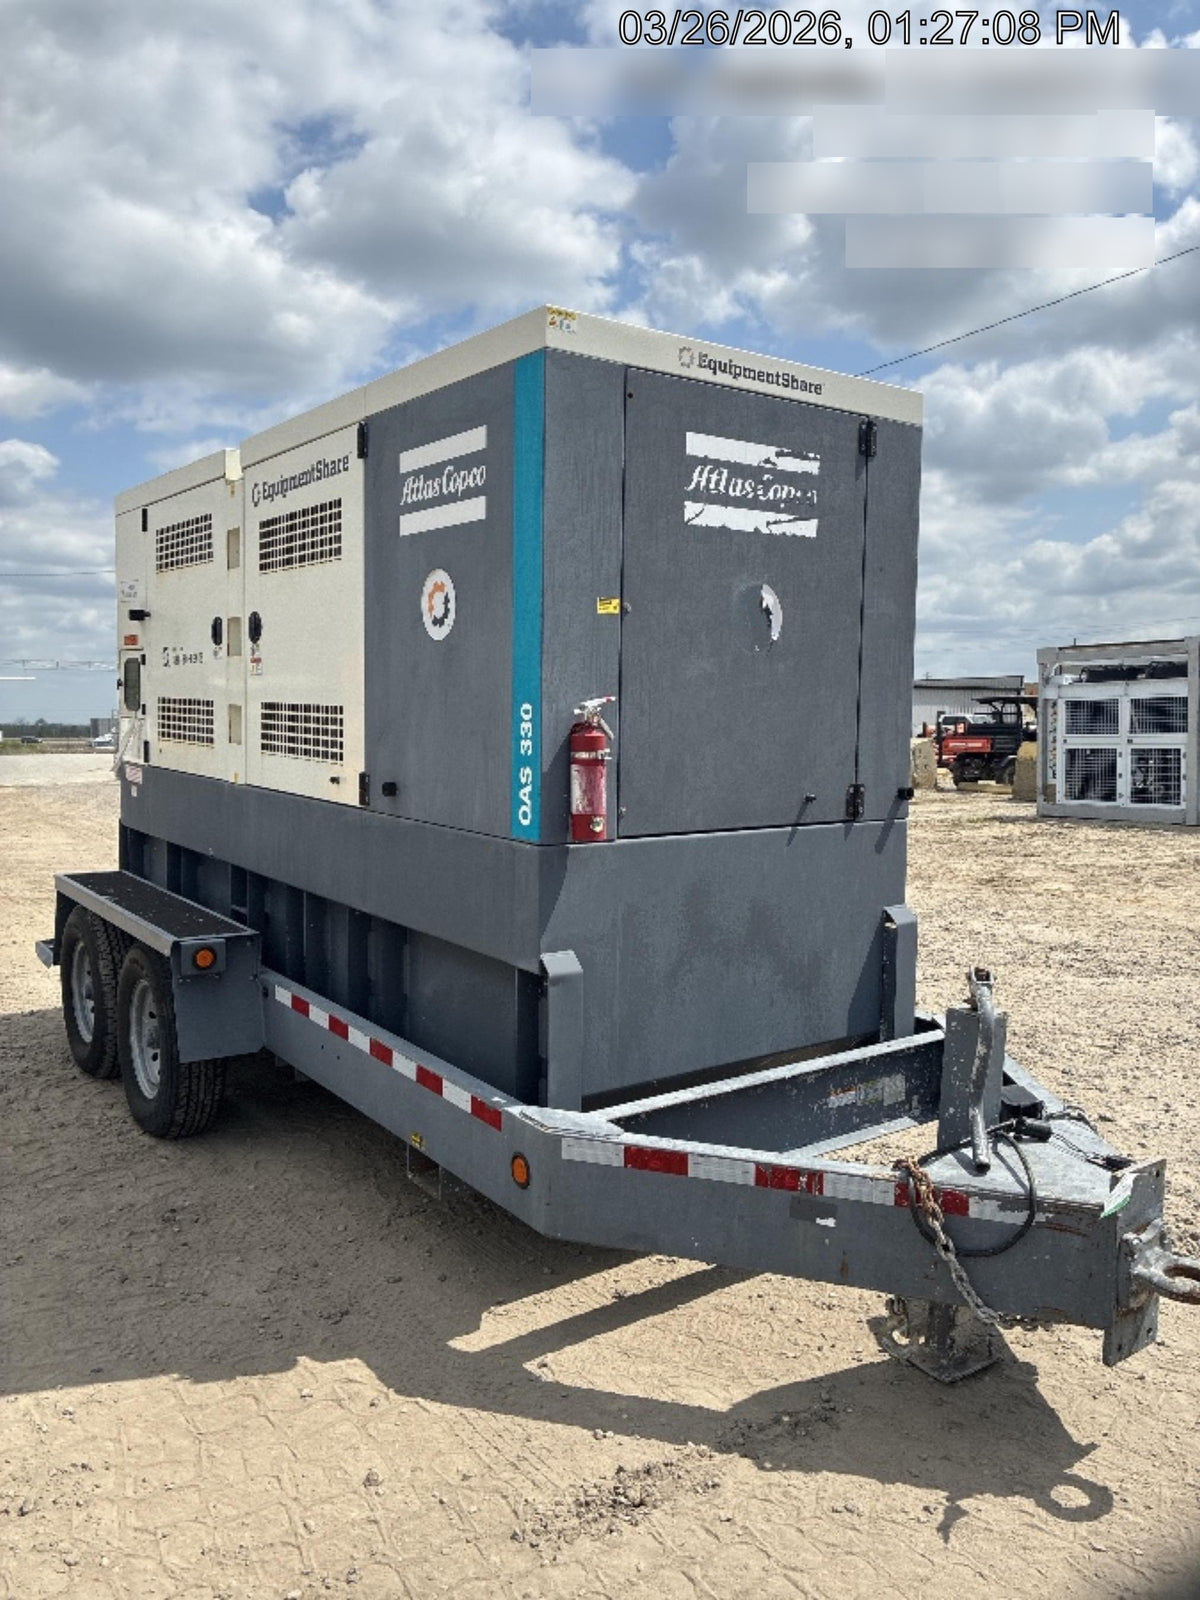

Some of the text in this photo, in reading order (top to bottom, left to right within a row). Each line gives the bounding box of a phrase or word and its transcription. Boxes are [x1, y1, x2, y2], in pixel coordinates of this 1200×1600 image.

[698, 351, 823, 396] EquipmentShare
[262, 455, 350, 503] EquipmentShare
[400, 465, 487, 506] Atlas Copco
[518, 702, 533, 826] OAS 330
